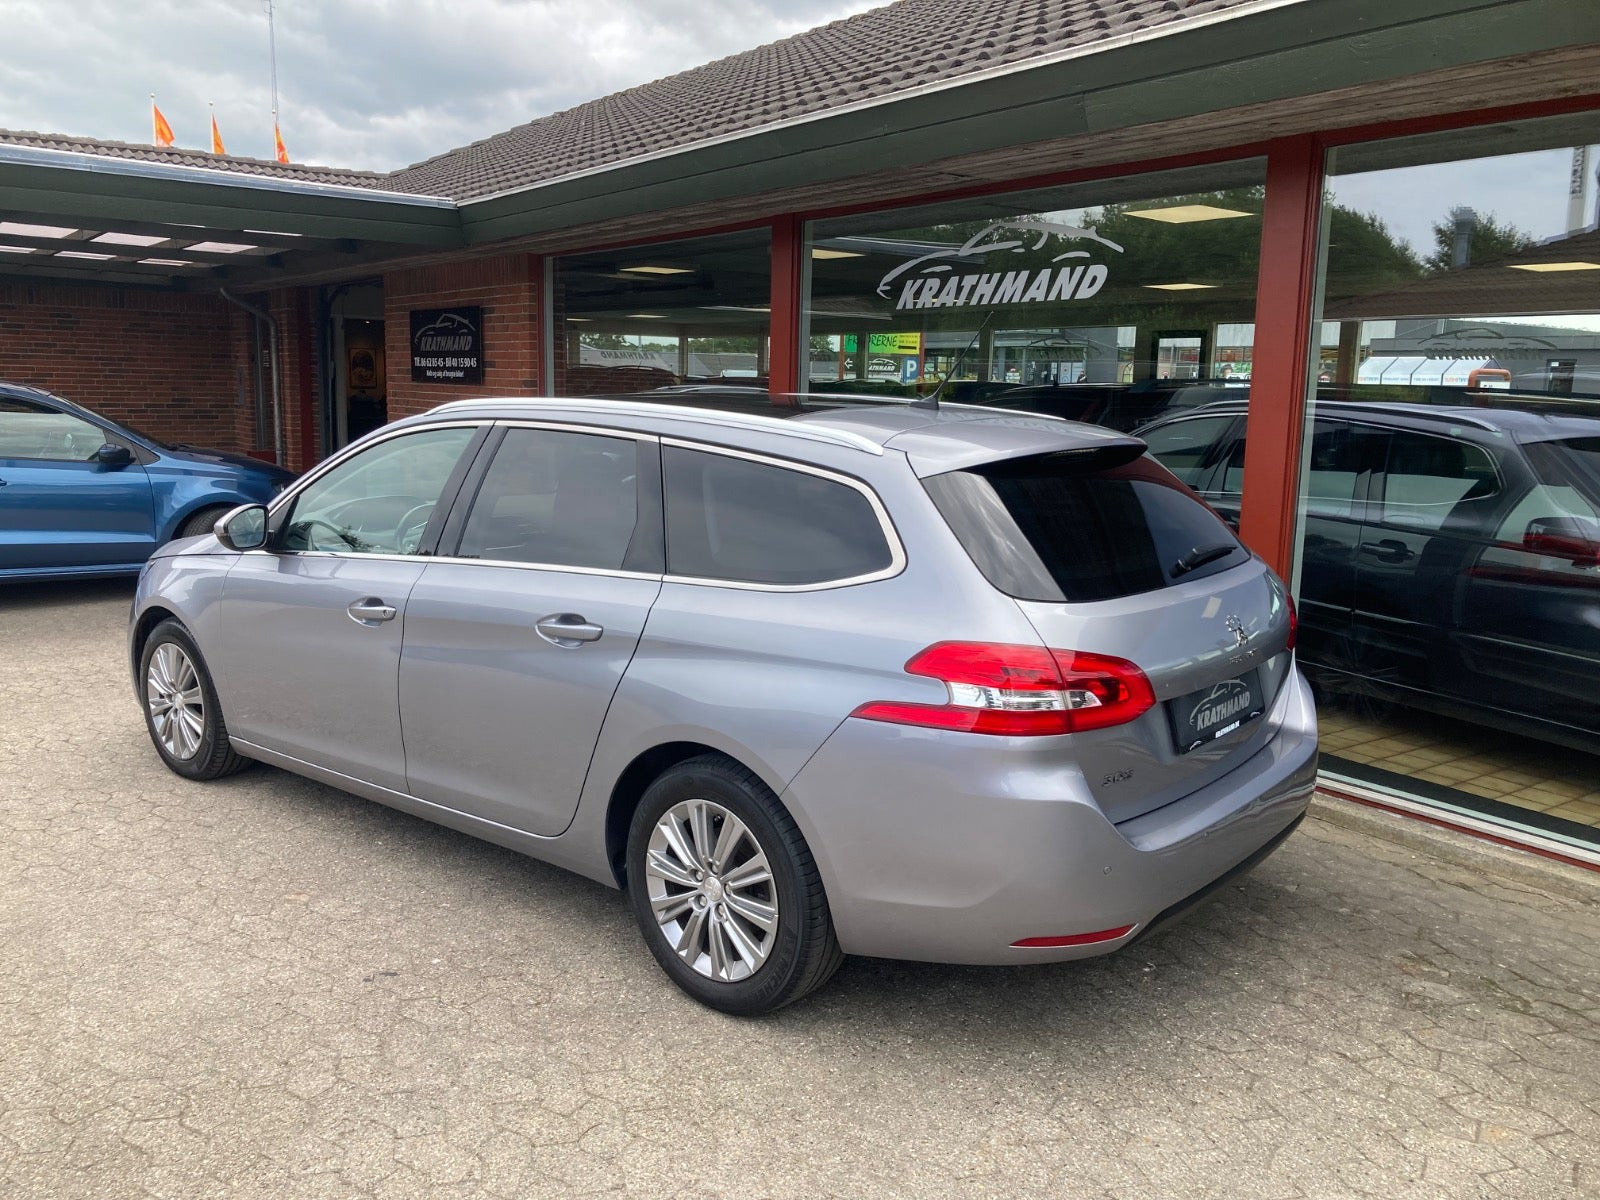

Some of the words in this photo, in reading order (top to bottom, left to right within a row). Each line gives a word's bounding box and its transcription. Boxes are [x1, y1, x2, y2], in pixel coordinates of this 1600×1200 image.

[896, 264, 1109, 310] KRATHMAND
[421, 336, 473, 351] KRATHMAND
[458, 357, 464, 367] 15
[464, 357, 470, 367] 90
[470, 357, 477, 368] 45
[906, 360, 917, 377] P
[1196, 691, 1251, 731] KRATHMAND
